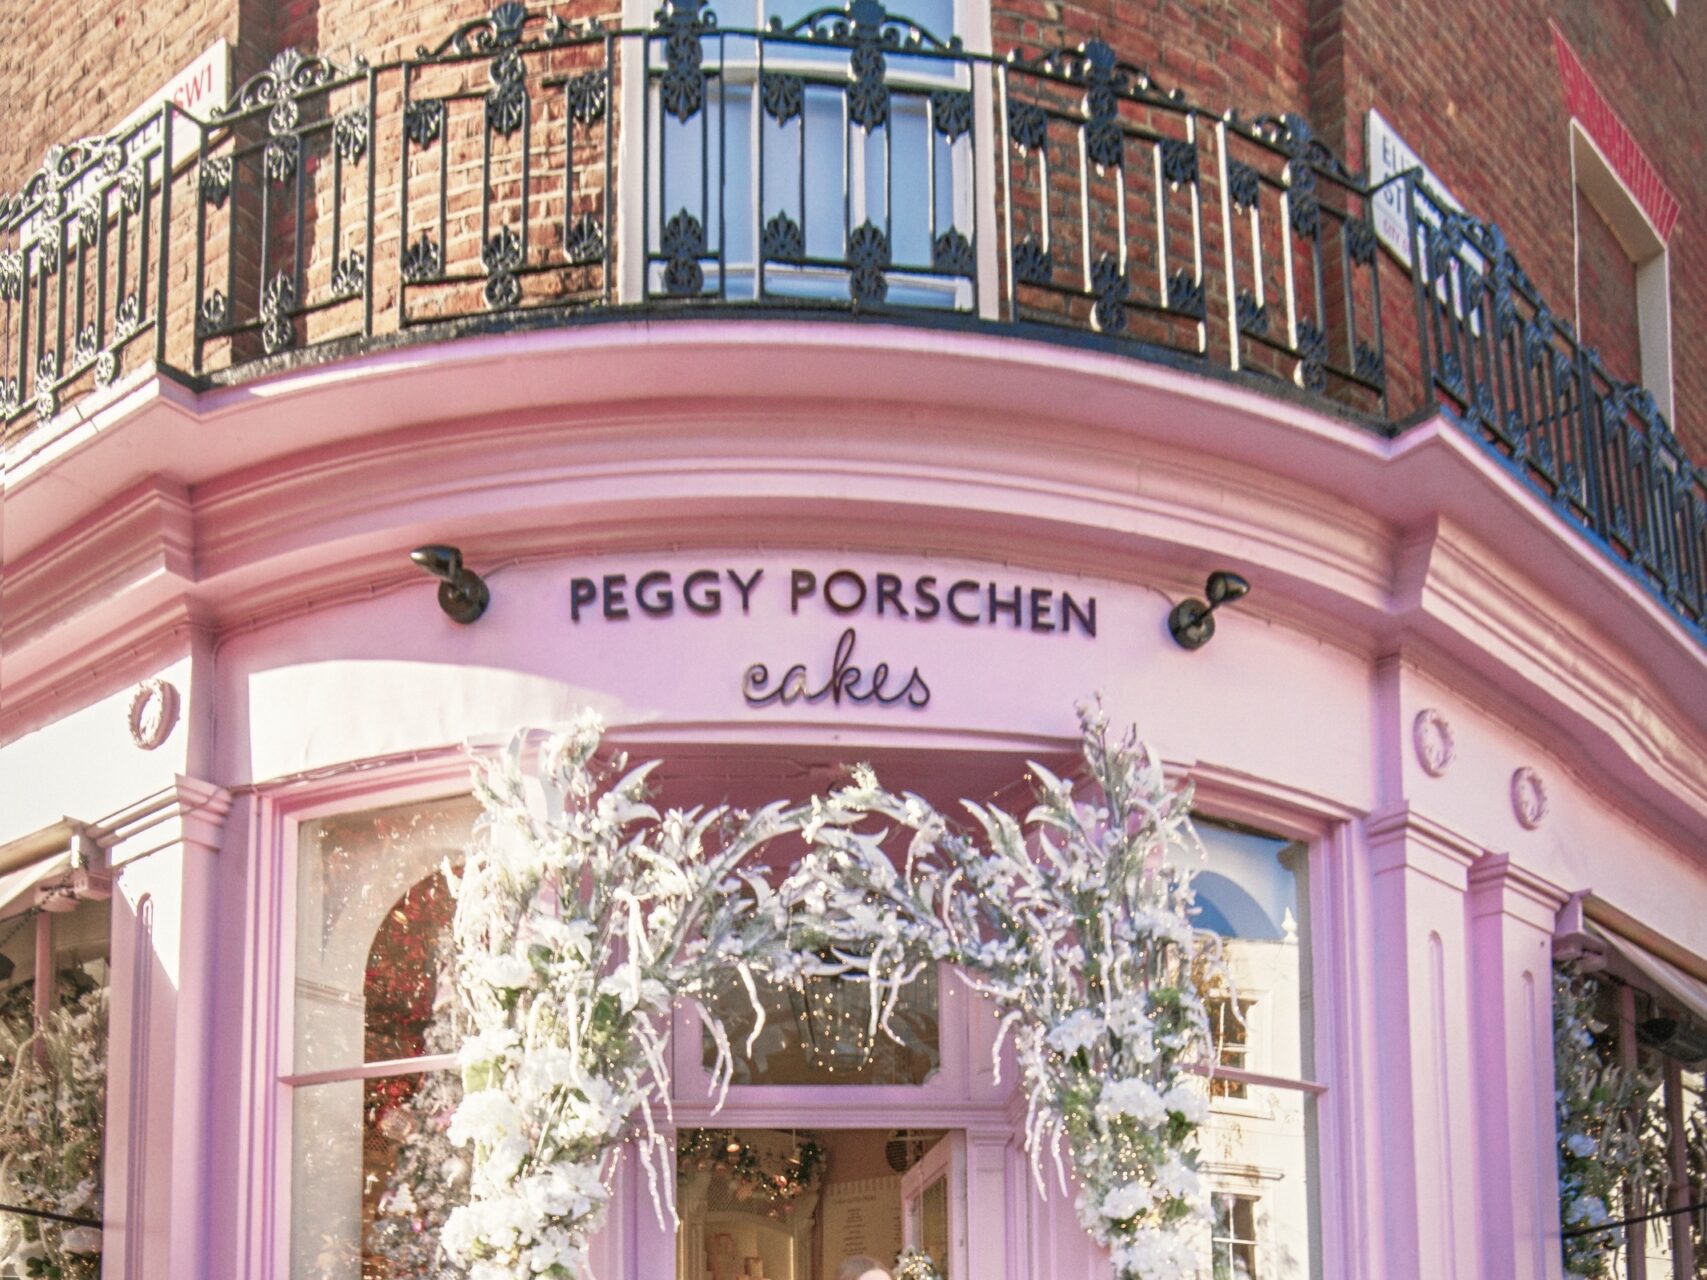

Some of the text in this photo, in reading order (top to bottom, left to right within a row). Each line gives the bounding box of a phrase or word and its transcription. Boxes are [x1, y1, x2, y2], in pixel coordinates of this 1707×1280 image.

[570, 568, 1098, 638] PEGGY PORSCHEN
[742, 628, 931, 708] cakes
